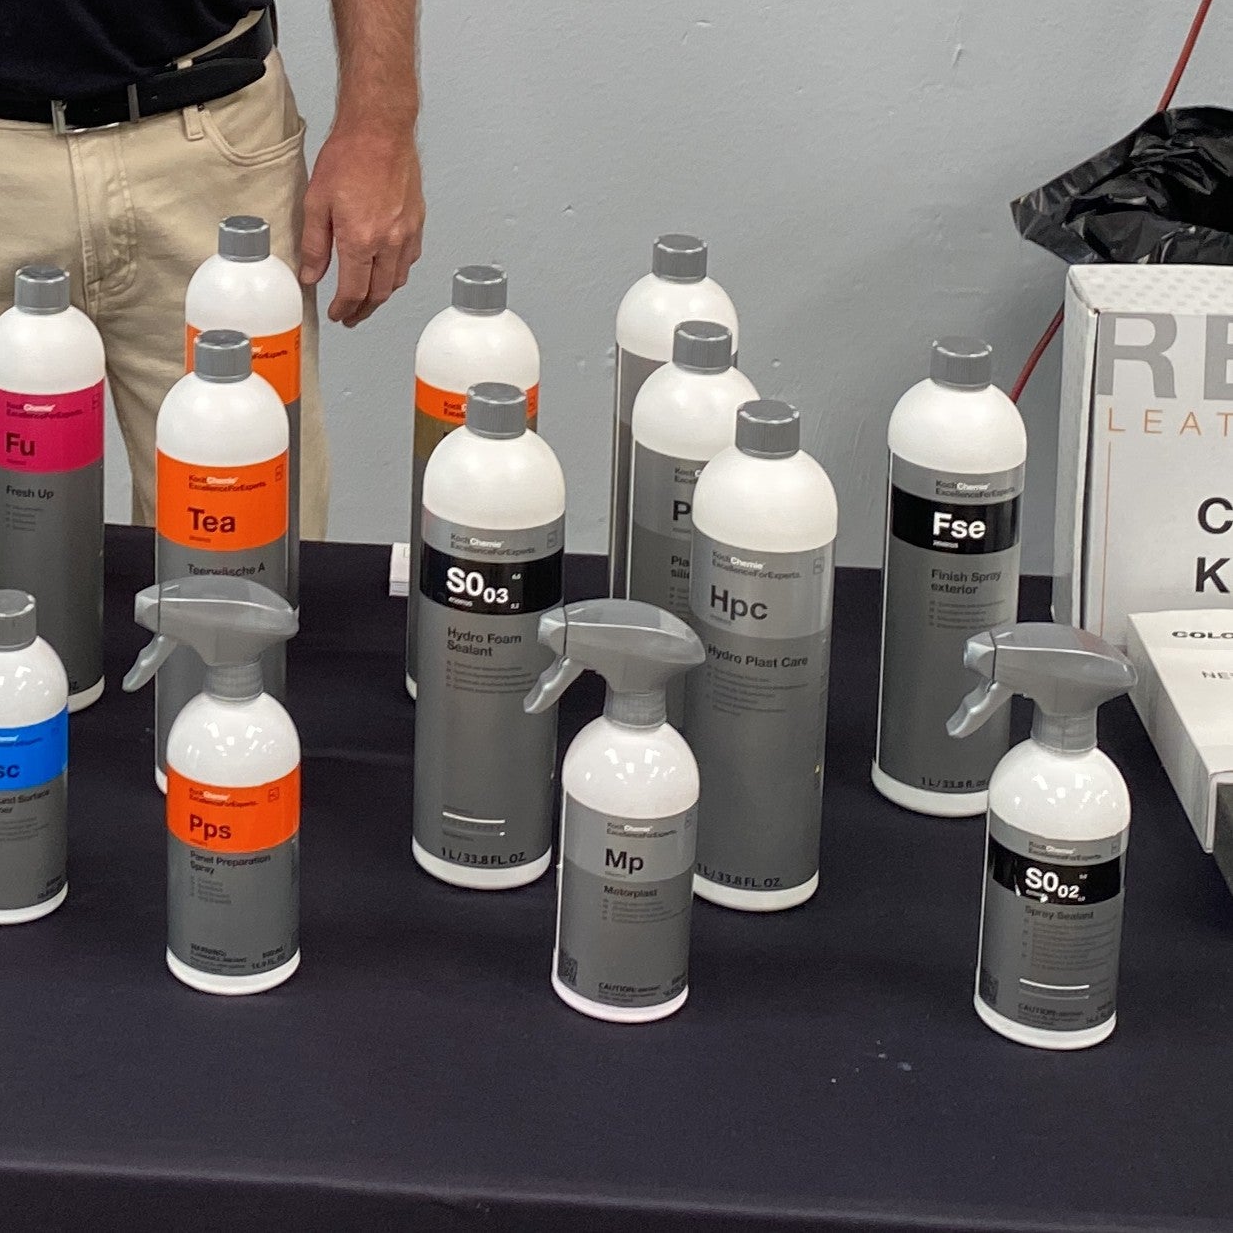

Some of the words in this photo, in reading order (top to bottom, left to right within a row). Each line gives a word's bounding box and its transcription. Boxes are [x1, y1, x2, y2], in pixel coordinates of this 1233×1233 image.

[6, 431, 36, 456] Fu
[6, 484, 35, 498] Fresh
[37, 487, 54, 500] Up
[187, 506, 236, 533] Tea
[933, 511, 987, 540] Fse
[931, 569, 968, 583] Finish
[970, 571, 1002, 583] Spray
[931, 582, 979, 595] exterior
[710, 584, 768, 621] Hpc
[447, 626, 484, 645] Hydro
[487, 632, 522, 645] Foam
[446, 640, 493, 657] Sealant
[707, 644, 742, 665] Hydro
[745, 655, 777, 668] Plast
[781, 656, 809, 668] Care
[189, 813, 232, 841] Pps
[604, 848, 644, 875] Mp
